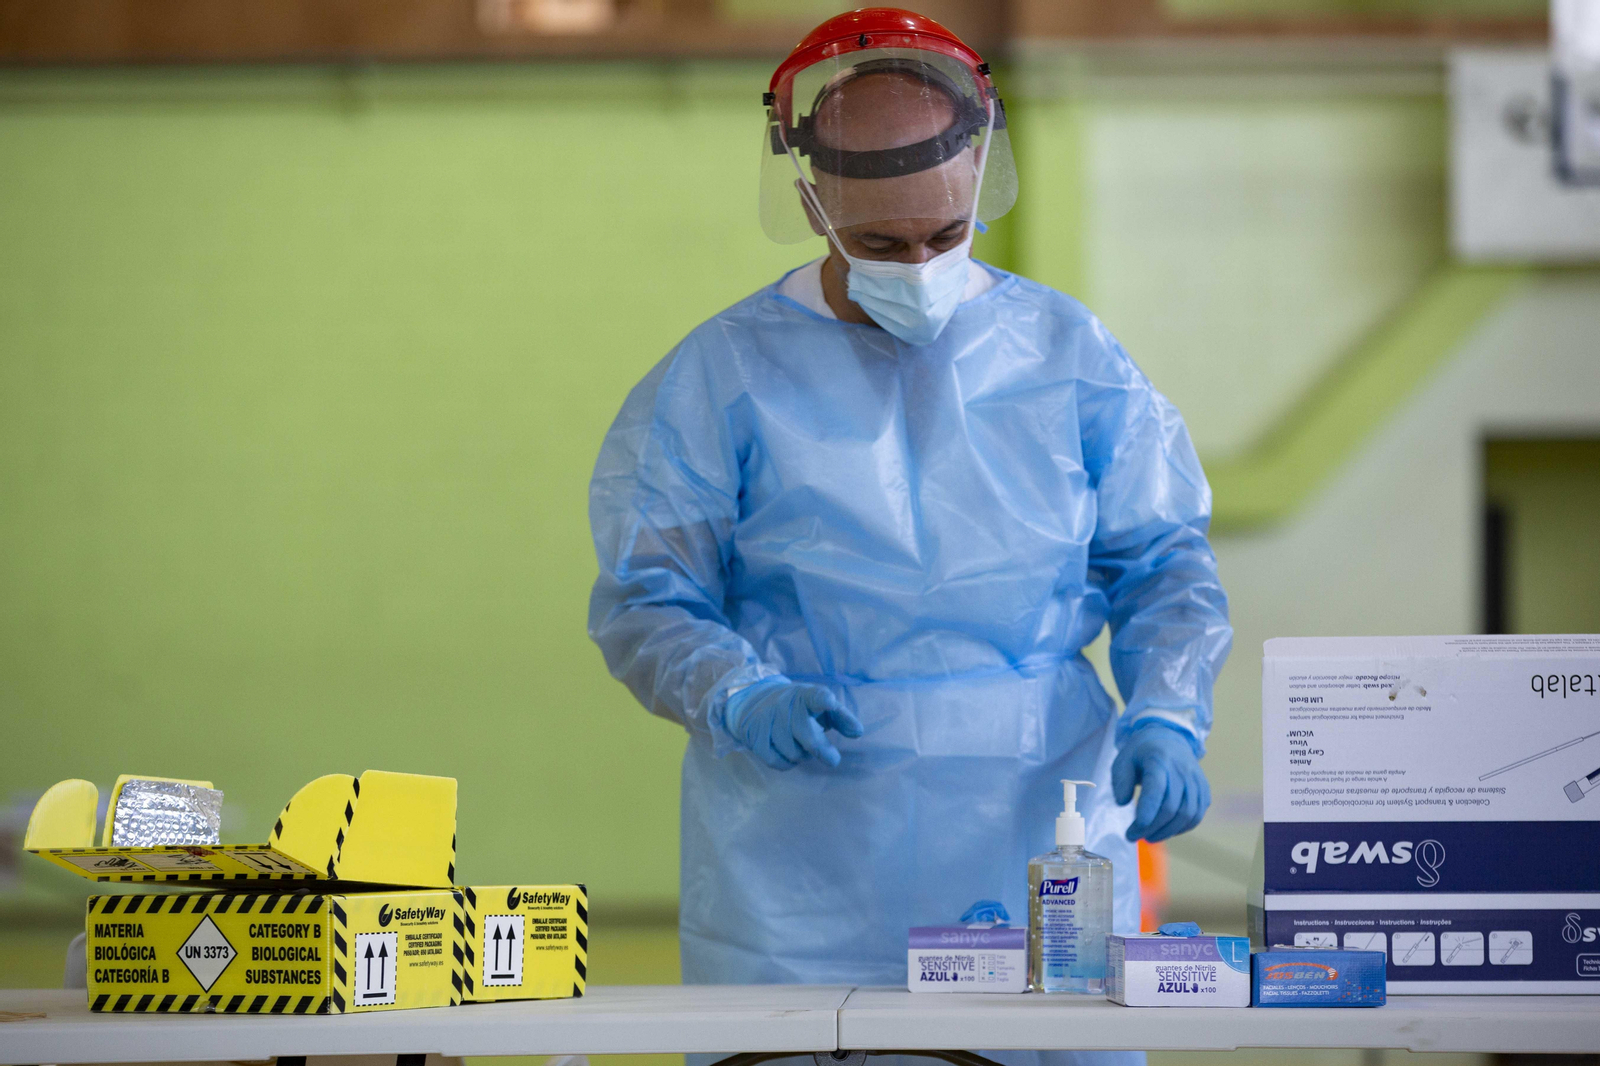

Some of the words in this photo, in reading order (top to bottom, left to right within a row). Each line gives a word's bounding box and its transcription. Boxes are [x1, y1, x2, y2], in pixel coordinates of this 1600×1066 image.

[1532, 675, 1600, 698] talab
[1435, 786, 1465, 794] recogida
[1322, 799, 1374, 807] microbiological
[1043, 881, 1074, 893] Purell
[522, 892, 570, 906] SafetyWay
[395, 907, 446, 921] SafetyWay
[95, 924, 144, 938] MATERIA
[249, 924, 309, 938] CATEGORY
[313, 924, 321, 938] B
[942, 932, 990, 947] sanyc
[95, 943, 156, 960] BIOLÓGICA
[185, 946, 201, 958] UN
[204, 946, 229, 959] 3373
[252, 947, 321, 961] BIOLOGICAL
[1161, 944, 1213, 959] sanyc
[1232, 942, 1242, 962] L
[921, 962, 974, 971] SENSITIVE
[95, 966, 159, 983] CATEGORÍA
[162, 969, 169, 983] B
[246, 970, 321, 984] SUBSTANCES
[920, 972, 950, 981] AZUL
[1159, 971, 1216, 981] SENSITIVE
[1158, 983, 1190, 992] AZUL
